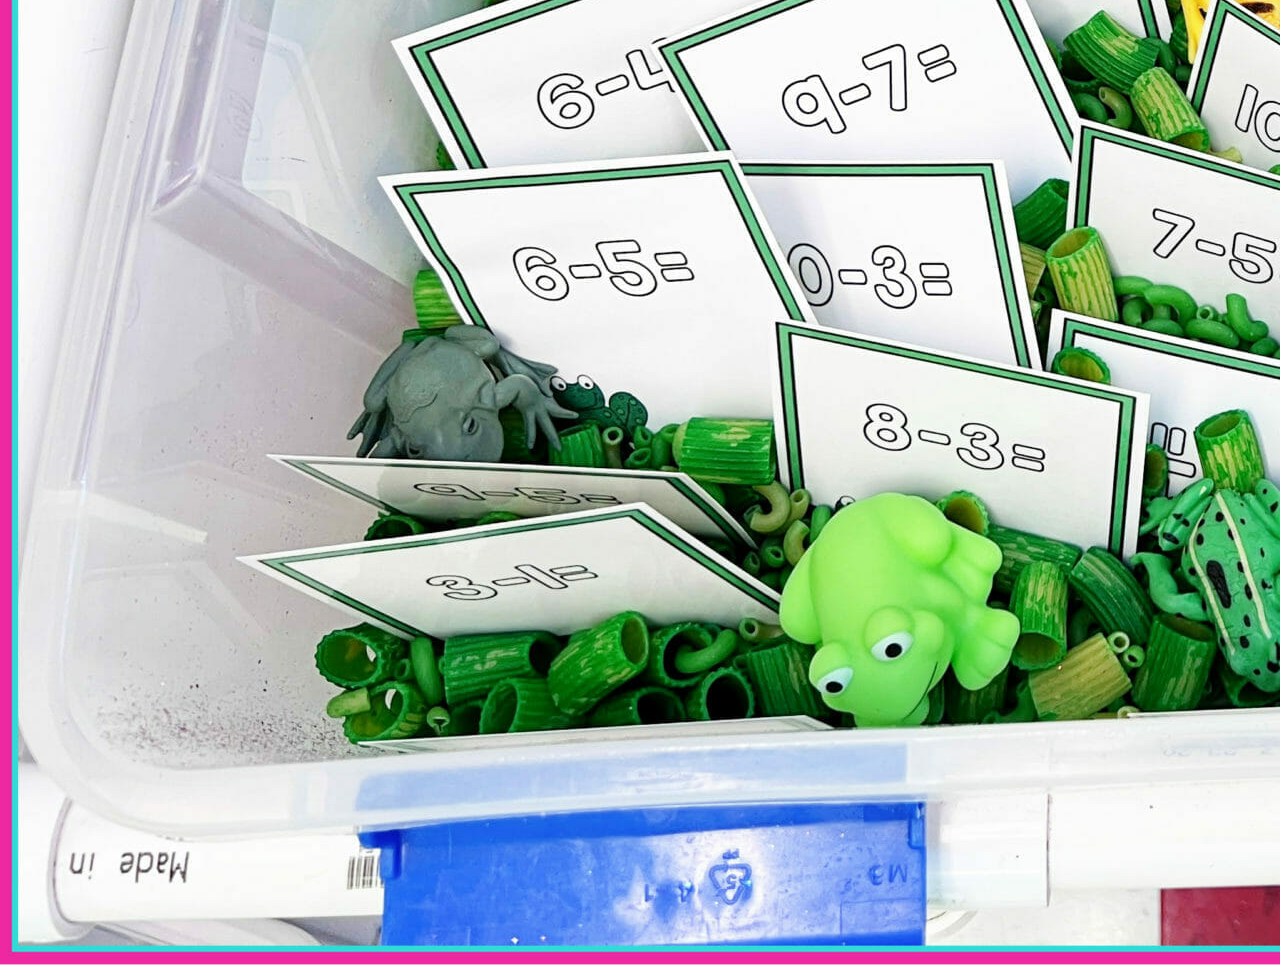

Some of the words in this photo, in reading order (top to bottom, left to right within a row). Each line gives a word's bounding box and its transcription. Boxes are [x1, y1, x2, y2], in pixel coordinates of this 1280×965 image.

[512, 239, 696, 302] 6-5=
[862, 402, 1048, 474] 8-3=
[425, 563, 600, 601] 3-1=
[69, 851, 96, 881] in
[119, 850, 191, 884] Made
